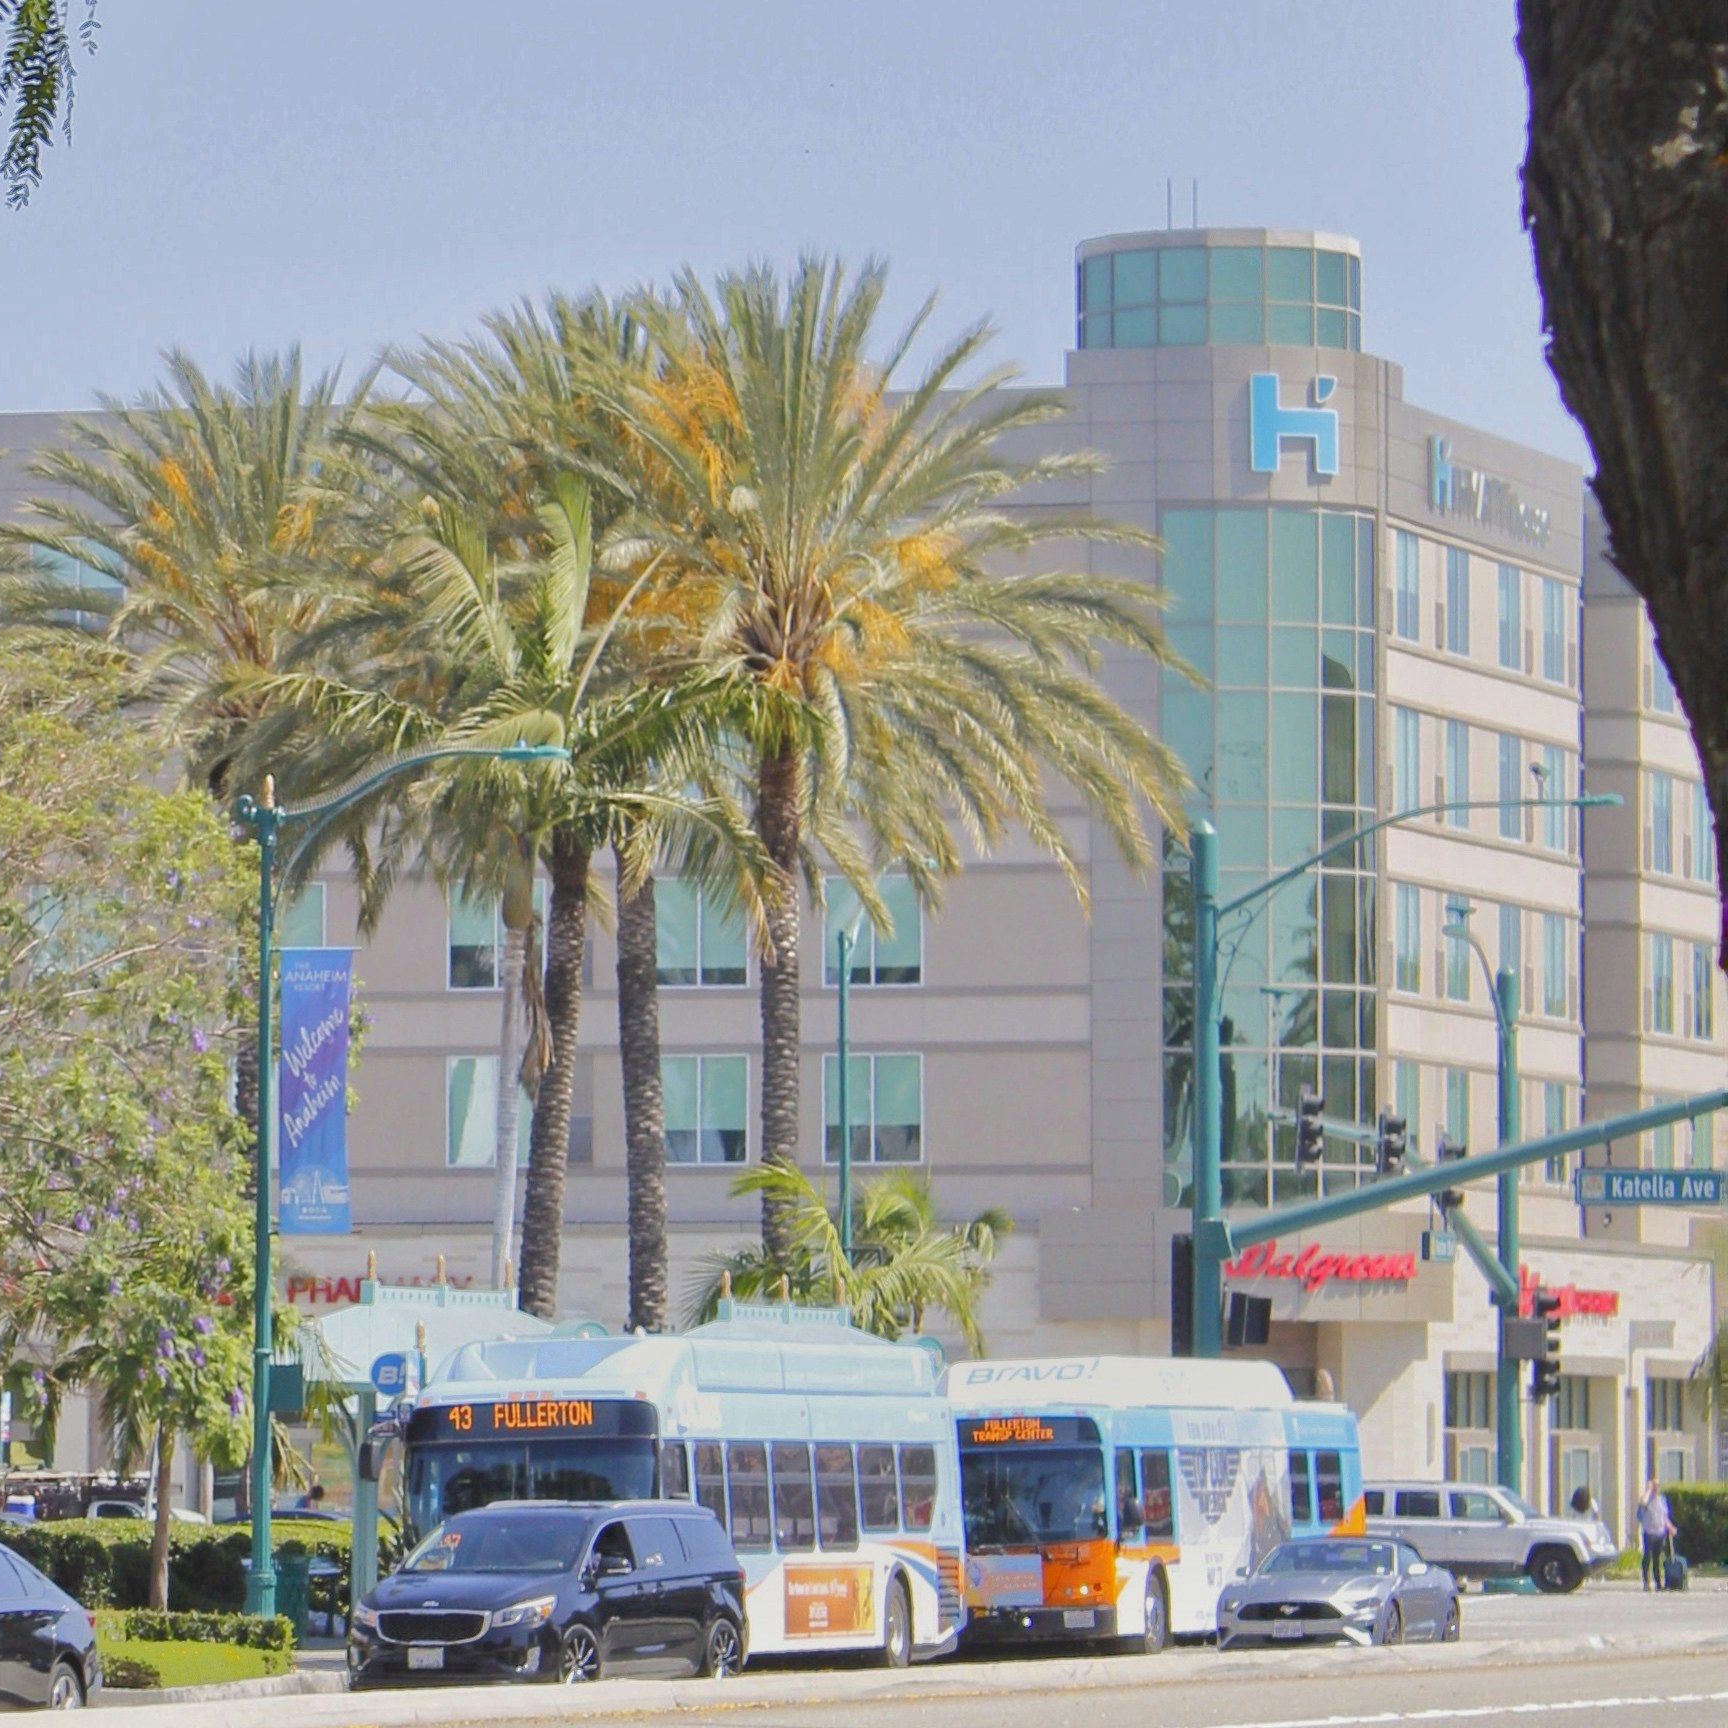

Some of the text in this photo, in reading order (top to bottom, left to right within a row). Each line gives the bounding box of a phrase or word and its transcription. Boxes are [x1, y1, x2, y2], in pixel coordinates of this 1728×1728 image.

[284, 970, 348, 983] ANAHEIM
[282, 1007, 344, 1078] Welcome
[302, 1071, 317, 1090] to
[283, 1074, 342, 1149] Anaheim
[1612, 1175, 1715, 1199] Katella Ave
[1224, 1239, 1418, 1292] Walgreens
[448, 1400, 593, 1430] 43 FULLERTON
[984, 1417, 1041, 1431] FULLERTON
[1014, 1428, 1054, 1441] CENTER
